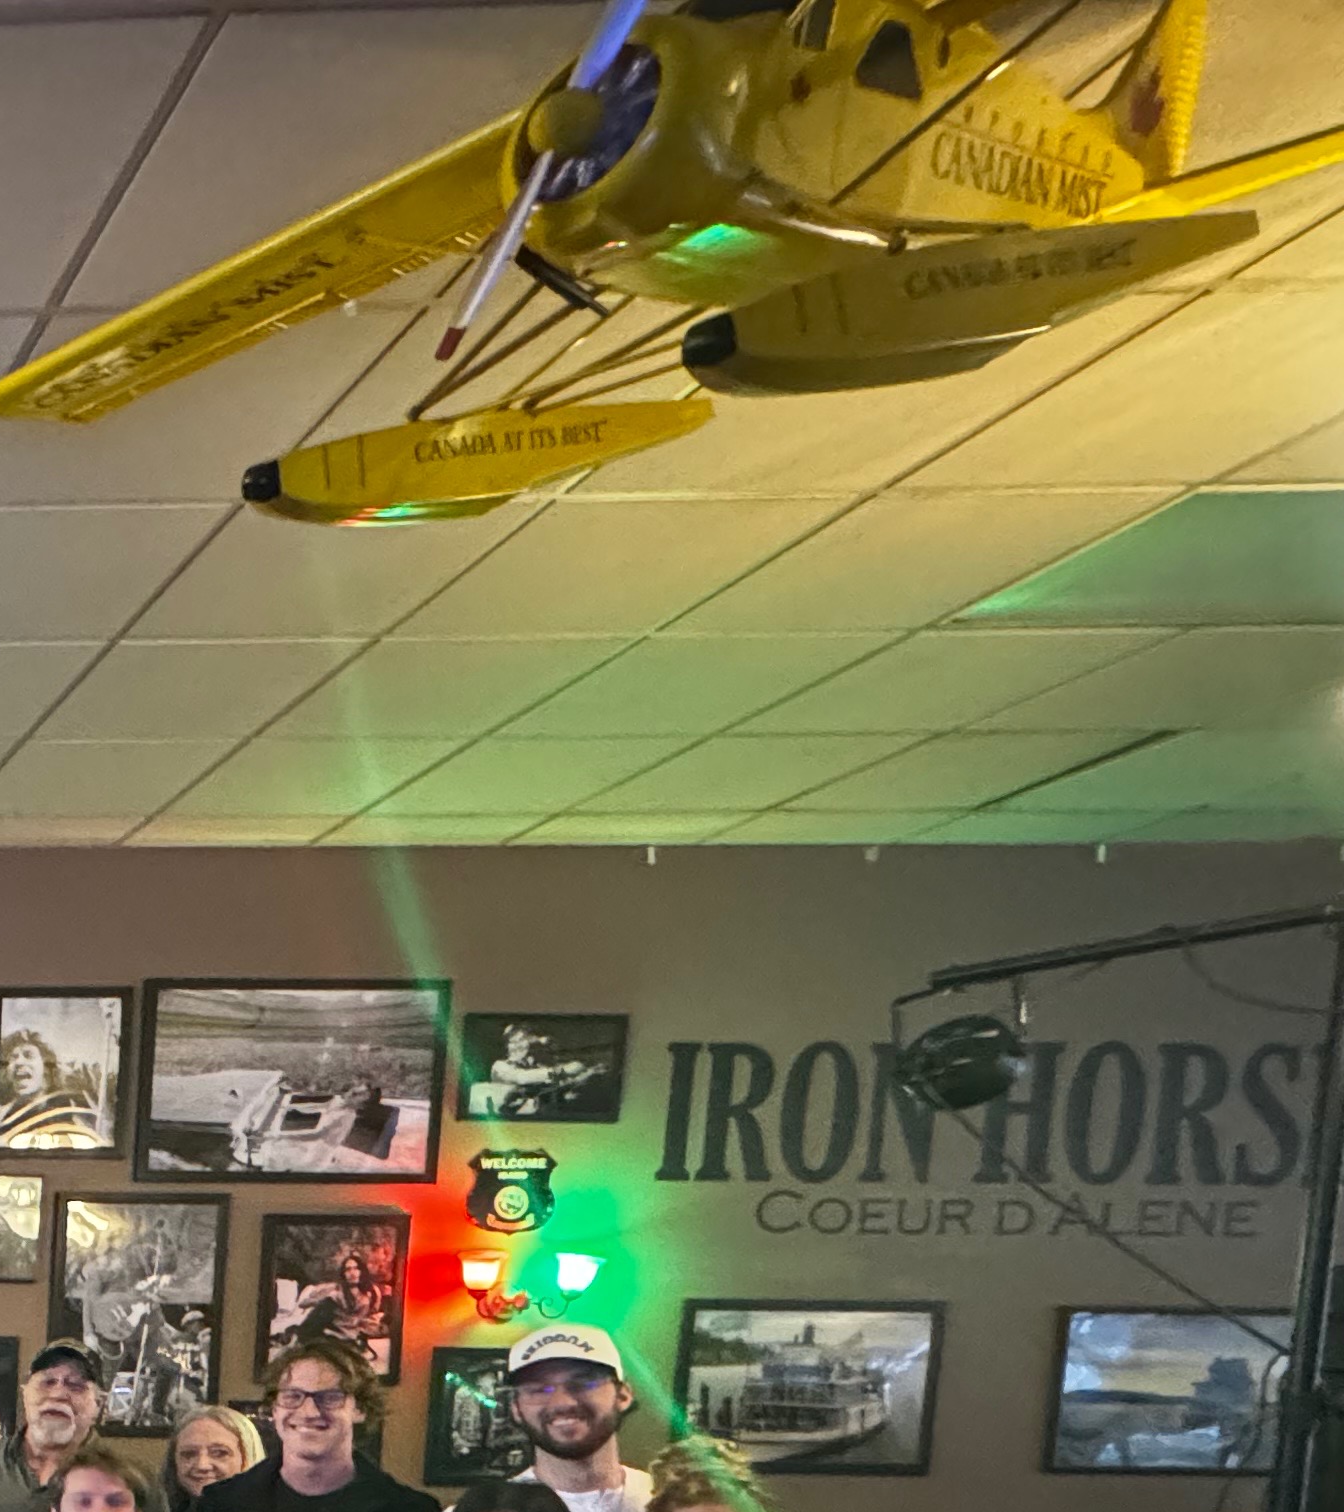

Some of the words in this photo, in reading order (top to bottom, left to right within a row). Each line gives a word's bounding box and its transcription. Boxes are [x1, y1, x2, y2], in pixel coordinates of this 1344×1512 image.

[414, 431, 497, 463] CANADA
[503, 430, 524, 451] AT
[529, 426, 557, 450] ITS
[655, 1041, 942, 1183] IRON
[975, 1041, 1315, 1186] HORS
[479, 1157, 547, 1170] WELCOME
[755, 1189, 974, 1236] COEUR
